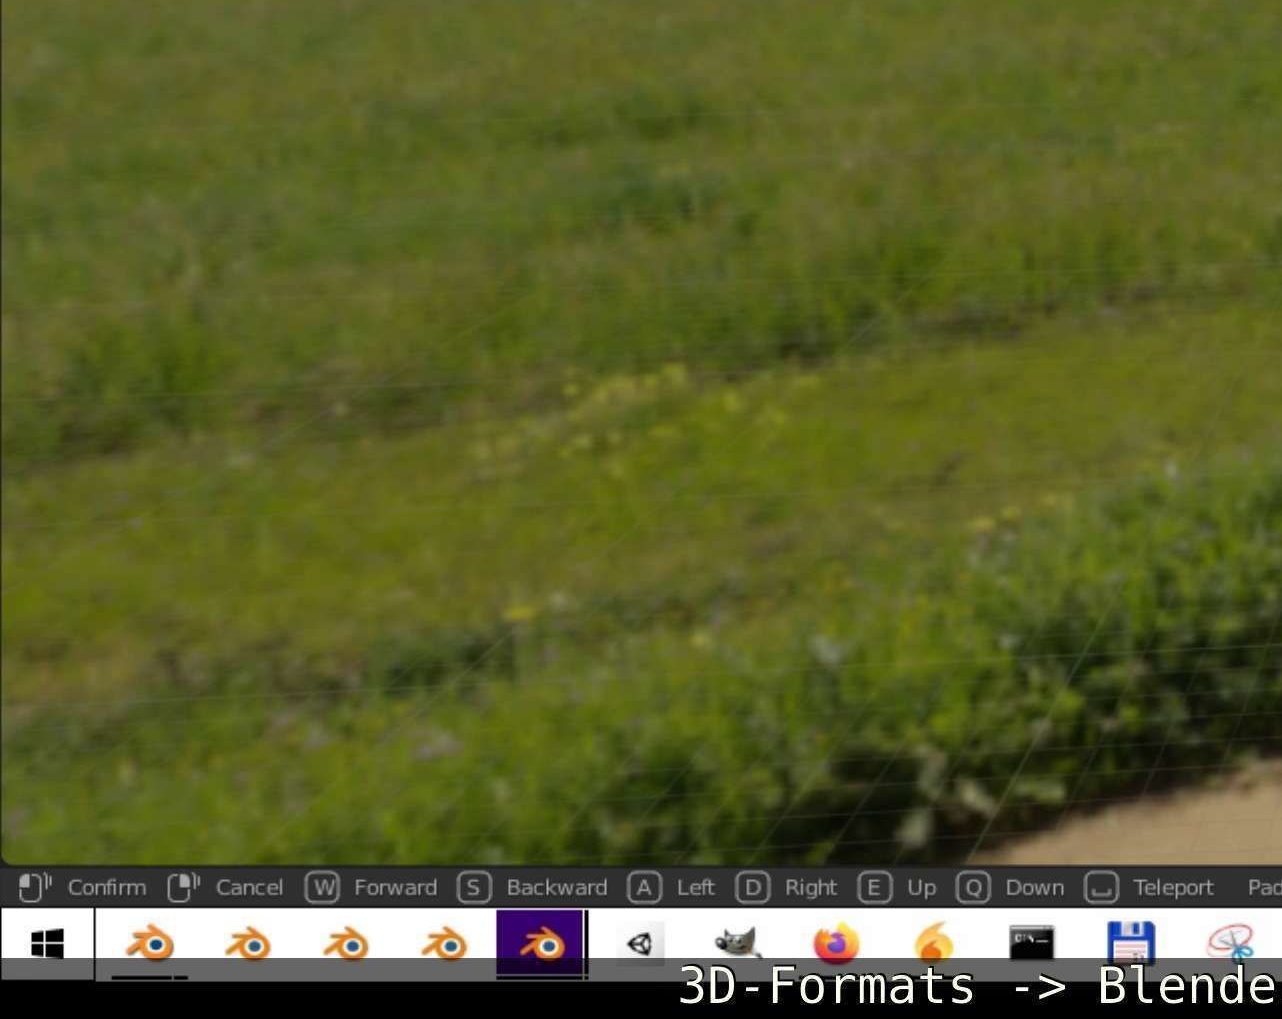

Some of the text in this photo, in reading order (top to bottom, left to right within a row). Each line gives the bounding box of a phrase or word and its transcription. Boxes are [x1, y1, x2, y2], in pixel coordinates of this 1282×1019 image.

[68, 878, 147, 896] Confirm
[216, 877, 283, 896] Cancel
[314, 877, 335, 897] W
[355, 877, 438, 896] Forward
[507, 877, 608, 896] Backward
[634, 877, 653, 897] A
[677, 878, 716, 896] Left
[745, 877, 762, 897] D
[786, 878, 838, 900] Right
[908, 878, 937, 900] Up
[965, 877, 983, 900] Q
[1006, 878, 1065, 896] Down
[1132, 877, 1215, 900] Teleport
